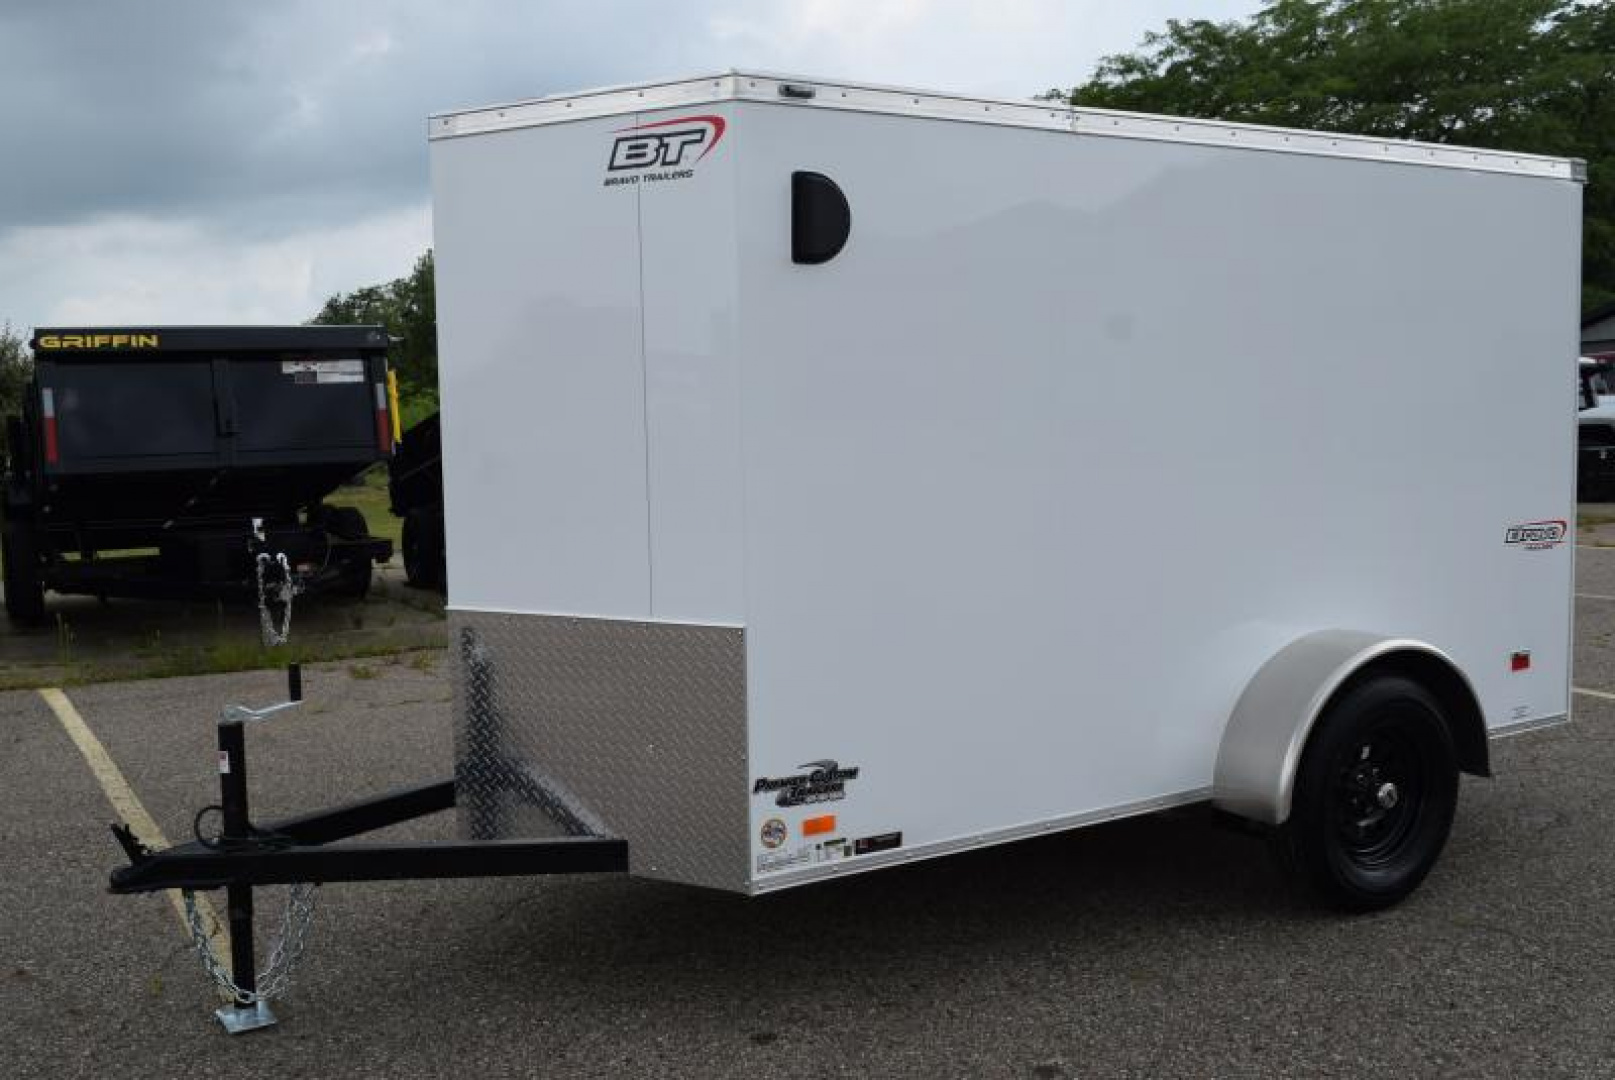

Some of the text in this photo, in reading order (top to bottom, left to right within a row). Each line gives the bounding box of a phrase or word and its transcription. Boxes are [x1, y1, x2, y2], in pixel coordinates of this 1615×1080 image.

[608, 128, 707, 171] BT
[603, 169, 694, 187] BRAVO TRAILERS
[38, 334, 159, 349] GRIFFIN
